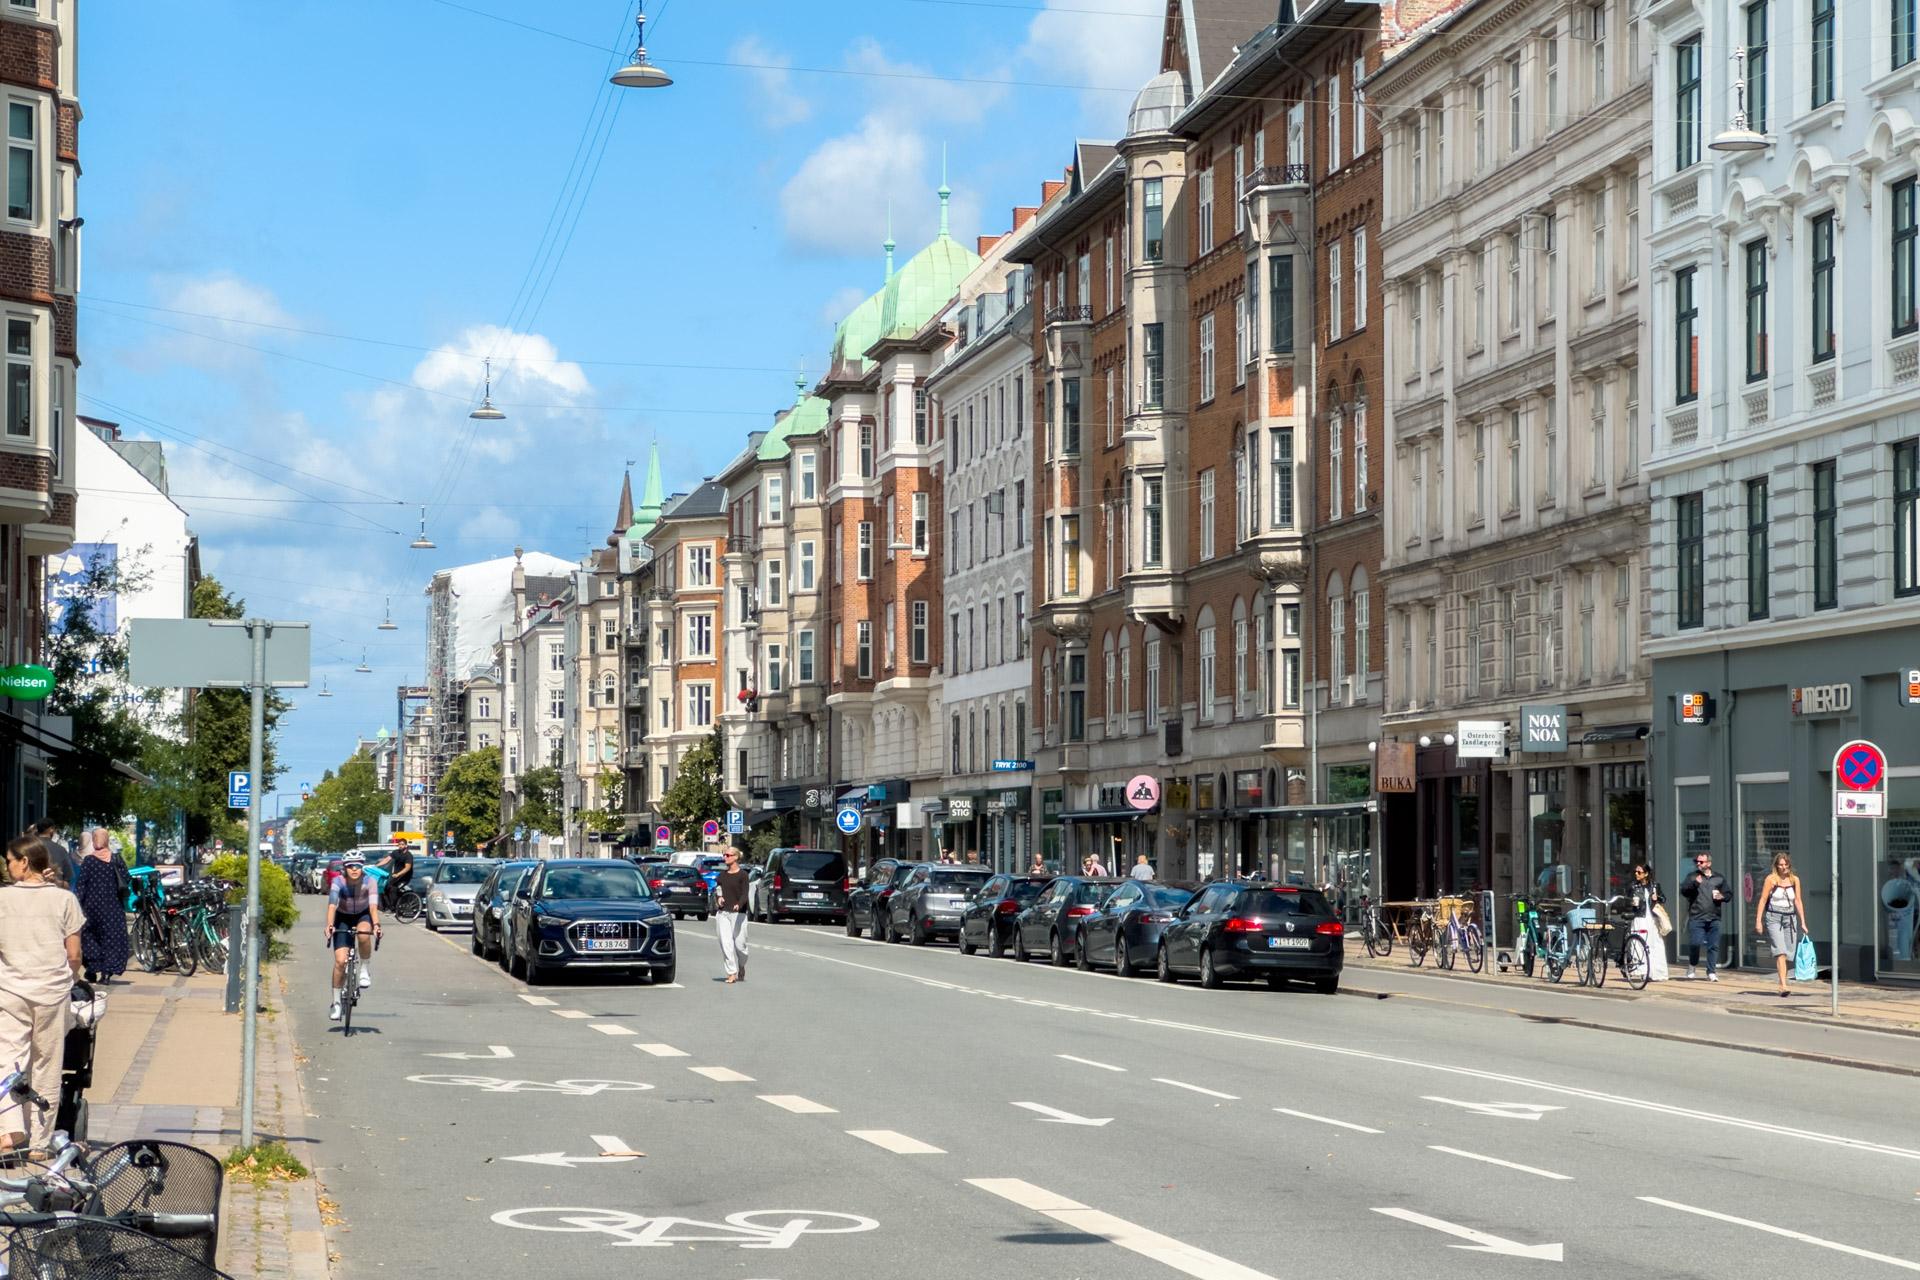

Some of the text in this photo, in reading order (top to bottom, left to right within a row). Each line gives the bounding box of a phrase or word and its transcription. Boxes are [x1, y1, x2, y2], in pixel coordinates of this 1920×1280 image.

[0, 676, 47, 688] Nielsen
[1802, 684, 1851, 714] IMERCO
[1528, 714, 1560, 729] NOA
[1528, 728, 1560, 742] NOA
[995, 761, 1011, 769] TRYK
[234, 774, 247, 792] P
[1381, 777, 1412, 790] BUKA
[950, 800, 972, 808] POUL
[731, 813, 740, 824] P
[951, 808, 970, 817] STIG
